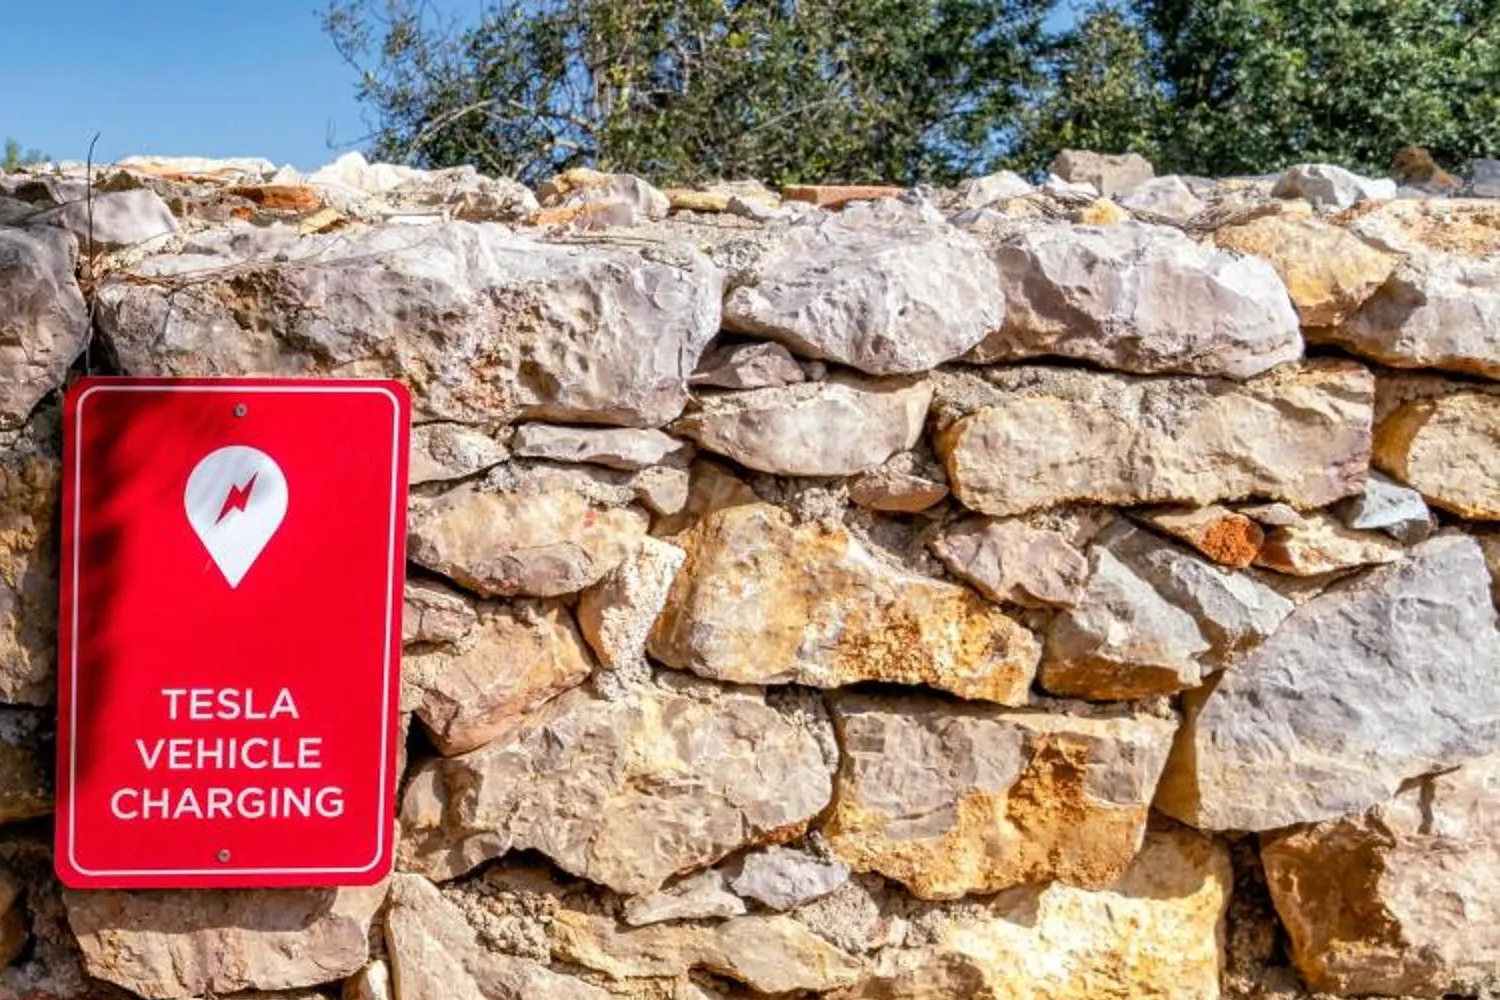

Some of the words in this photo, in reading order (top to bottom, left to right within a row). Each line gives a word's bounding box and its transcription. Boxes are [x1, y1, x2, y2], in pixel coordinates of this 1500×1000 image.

[161, 688, 299, 720] TESLA
[135, 737, 323, 769] VEHICLE
[110, 786, 345, 819] CHARGING
